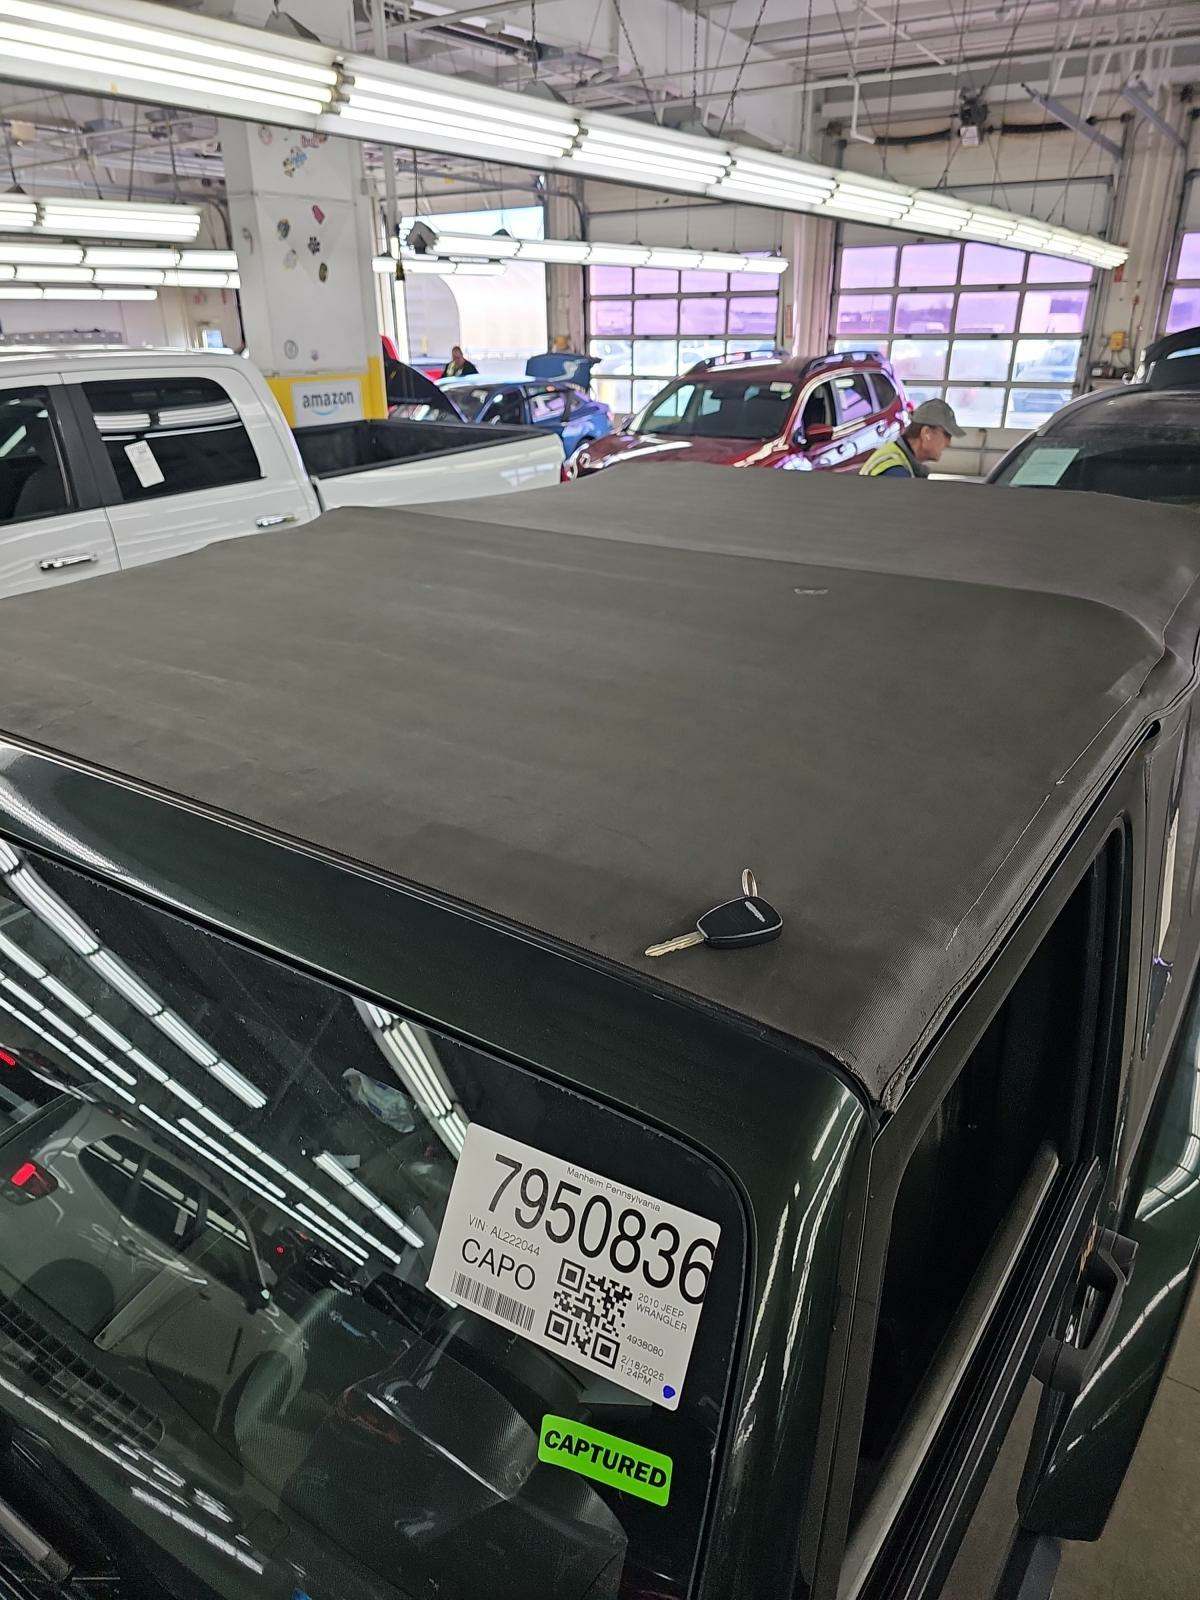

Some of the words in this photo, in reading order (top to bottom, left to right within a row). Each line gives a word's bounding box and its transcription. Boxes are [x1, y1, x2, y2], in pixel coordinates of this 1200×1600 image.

[302, 391, 354, 408] amazon
[566, 1167, 604, 1189] Manheim
[605, 1182, 661, 1213] Pennsylvania
[468, 1214, 488, 1232] VIN:
[490, 1226, 541, 1257] AL222044
[488, 1153, 716, 1305] 7950836
[462, 1238, 536, 1290] CAPO
[636, 1302, 688, 1333] WRANGLER
[638, 1293, 660, 1309] 2010
[661, 1304, 684, 1318] JEEP
[626, 1334, 664, 1358] 4938080
[620, 1355, 665, 1382] 2/18/2025
[544, 1430, 667, 1488] CAPTURED
